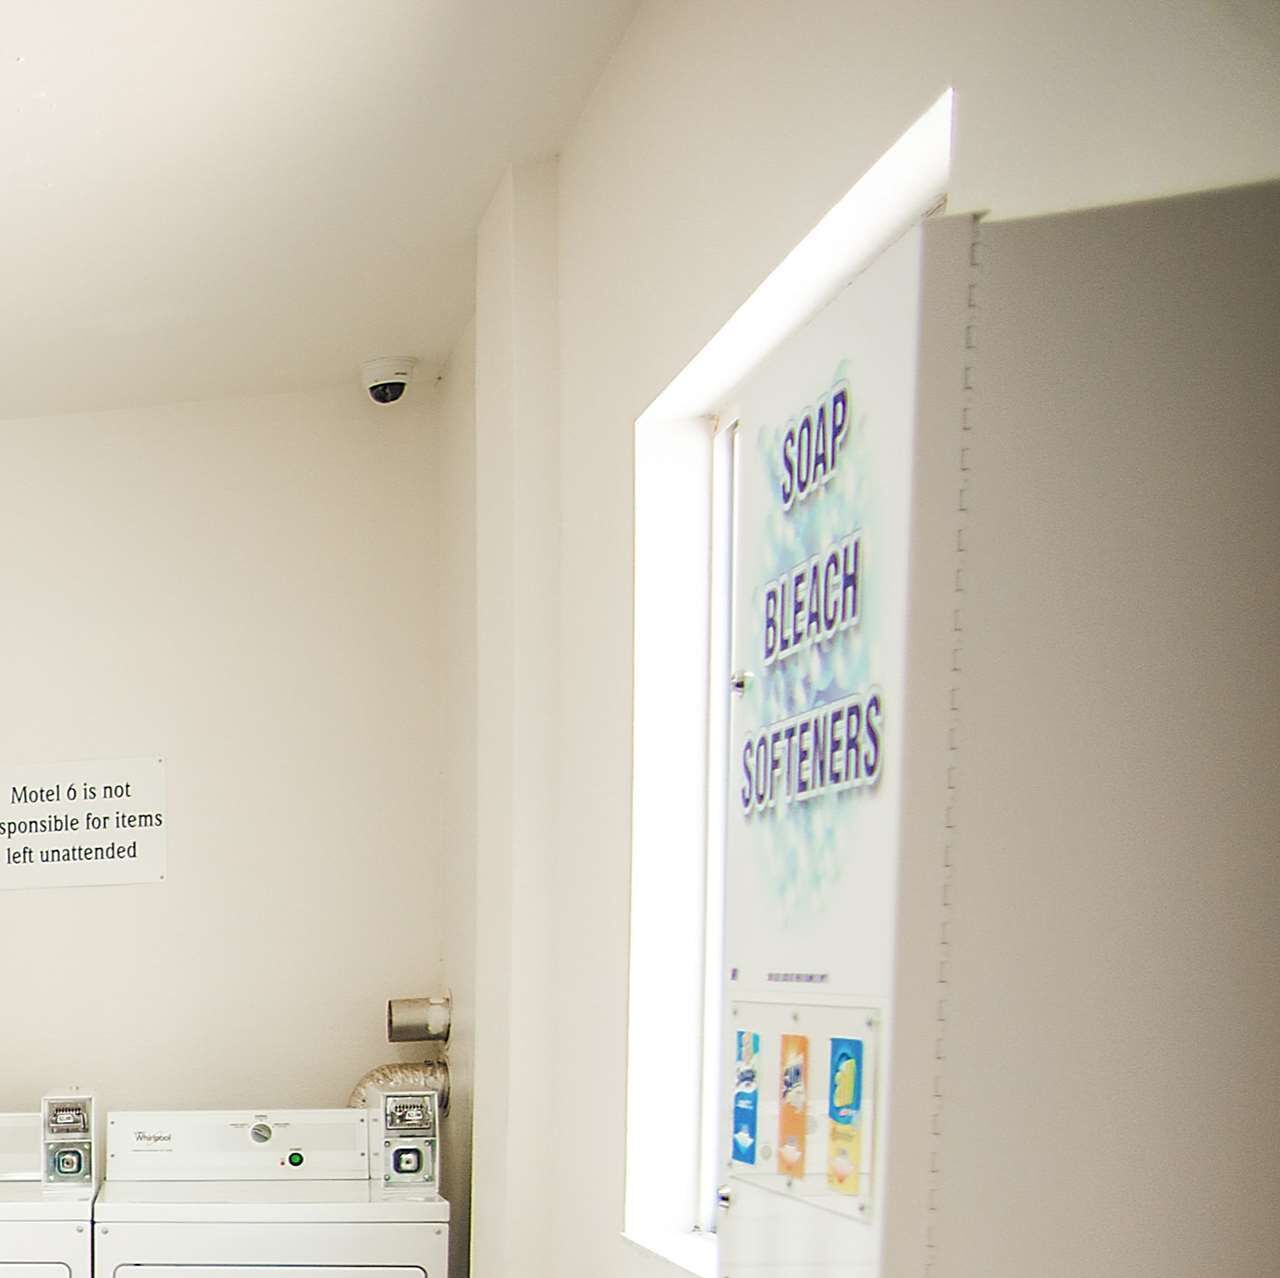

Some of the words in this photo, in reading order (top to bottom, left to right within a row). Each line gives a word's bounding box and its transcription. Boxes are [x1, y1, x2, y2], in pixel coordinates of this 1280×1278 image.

[781, 390, 849, 505] SOAP
[763, 538, 863, 661] BLEACH
[741, 694, 882, 810] SOFTENERS
[10, 784, 61, 805] Motel
[66, 782, 78, 802] 6
[82, 782, 97, 801] is
[102, 781, 132, 799] not
[85, 812, 111, 831] for
[115, 811, 164, 830] items
[6, 846, 35, 865] left
[39, 841, 138, 864] unattended
